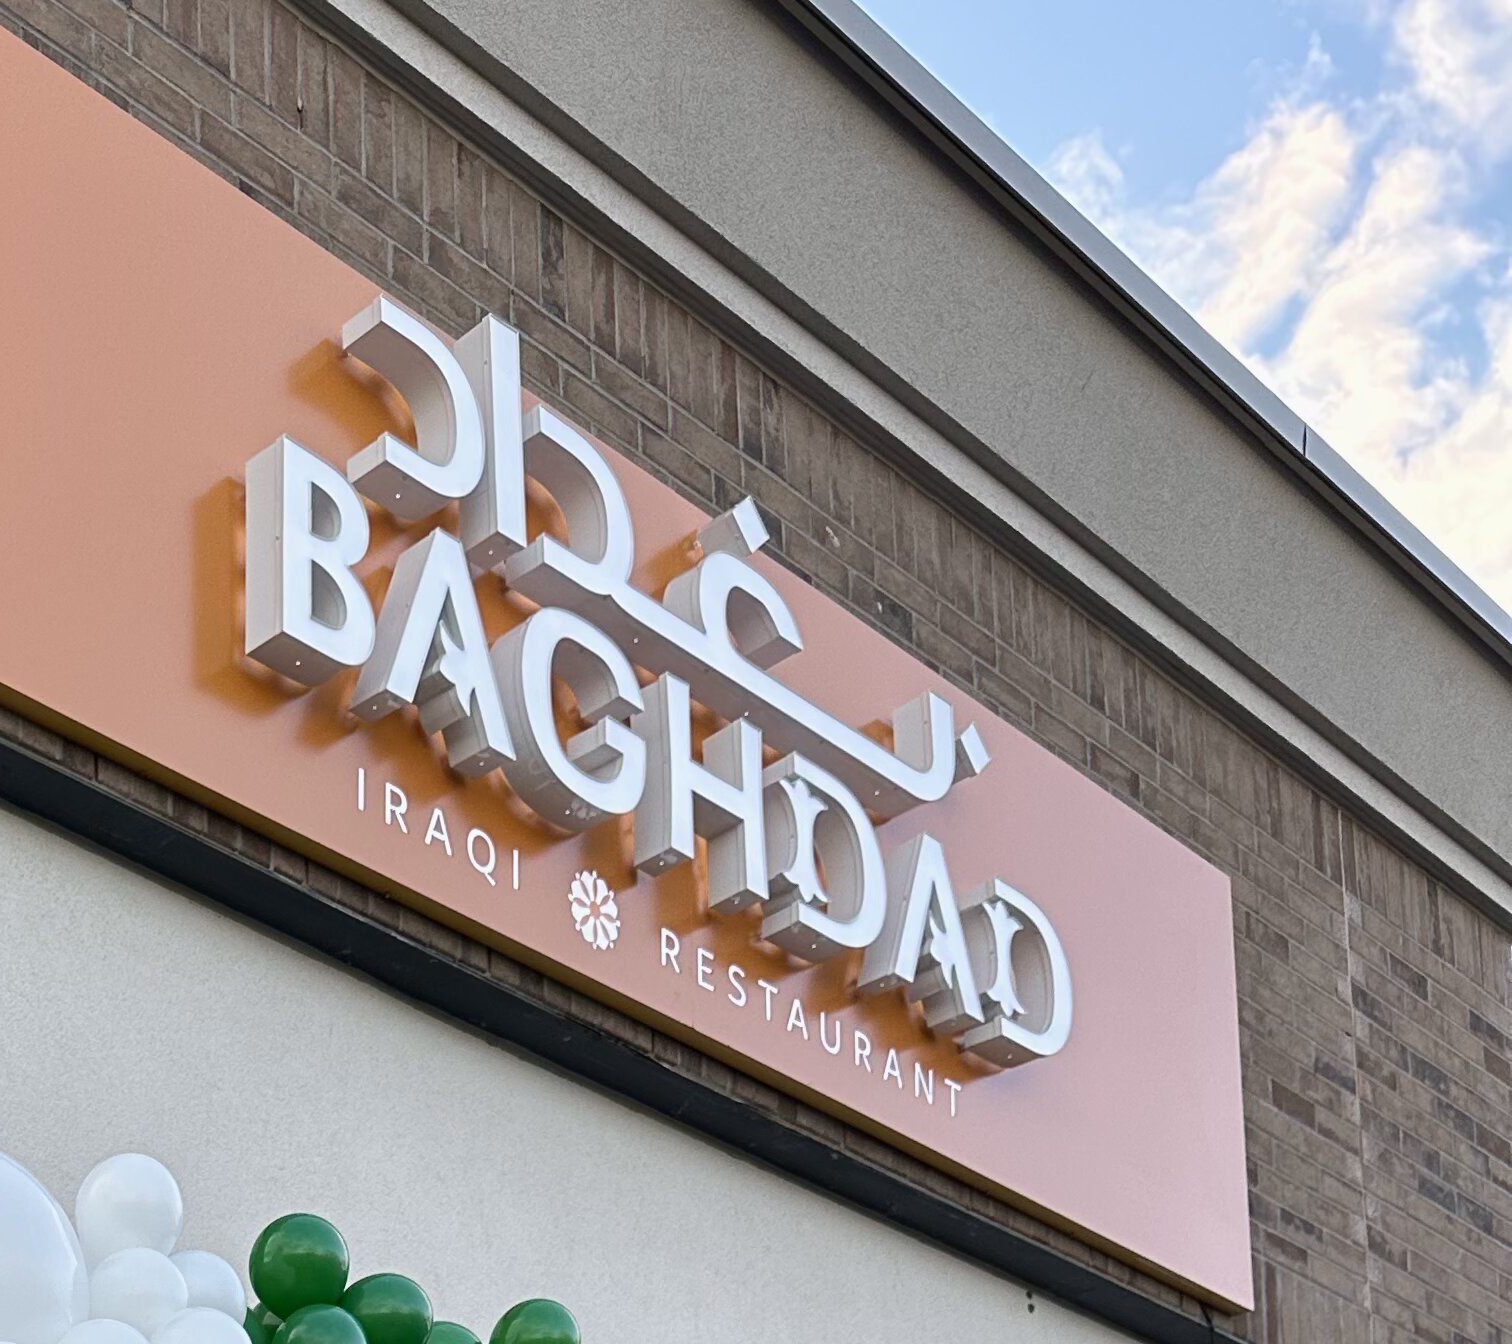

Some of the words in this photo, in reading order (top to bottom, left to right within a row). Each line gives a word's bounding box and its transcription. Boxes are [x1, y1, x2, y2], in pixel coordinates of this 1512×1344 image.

[248, 436, 1074, 1066] BAGHDAD
[344, 294, 992, 806] بغداد
[356, 767, 521, 891] IRAQI
[660, 927, 963, 1118] RESTAURANT
